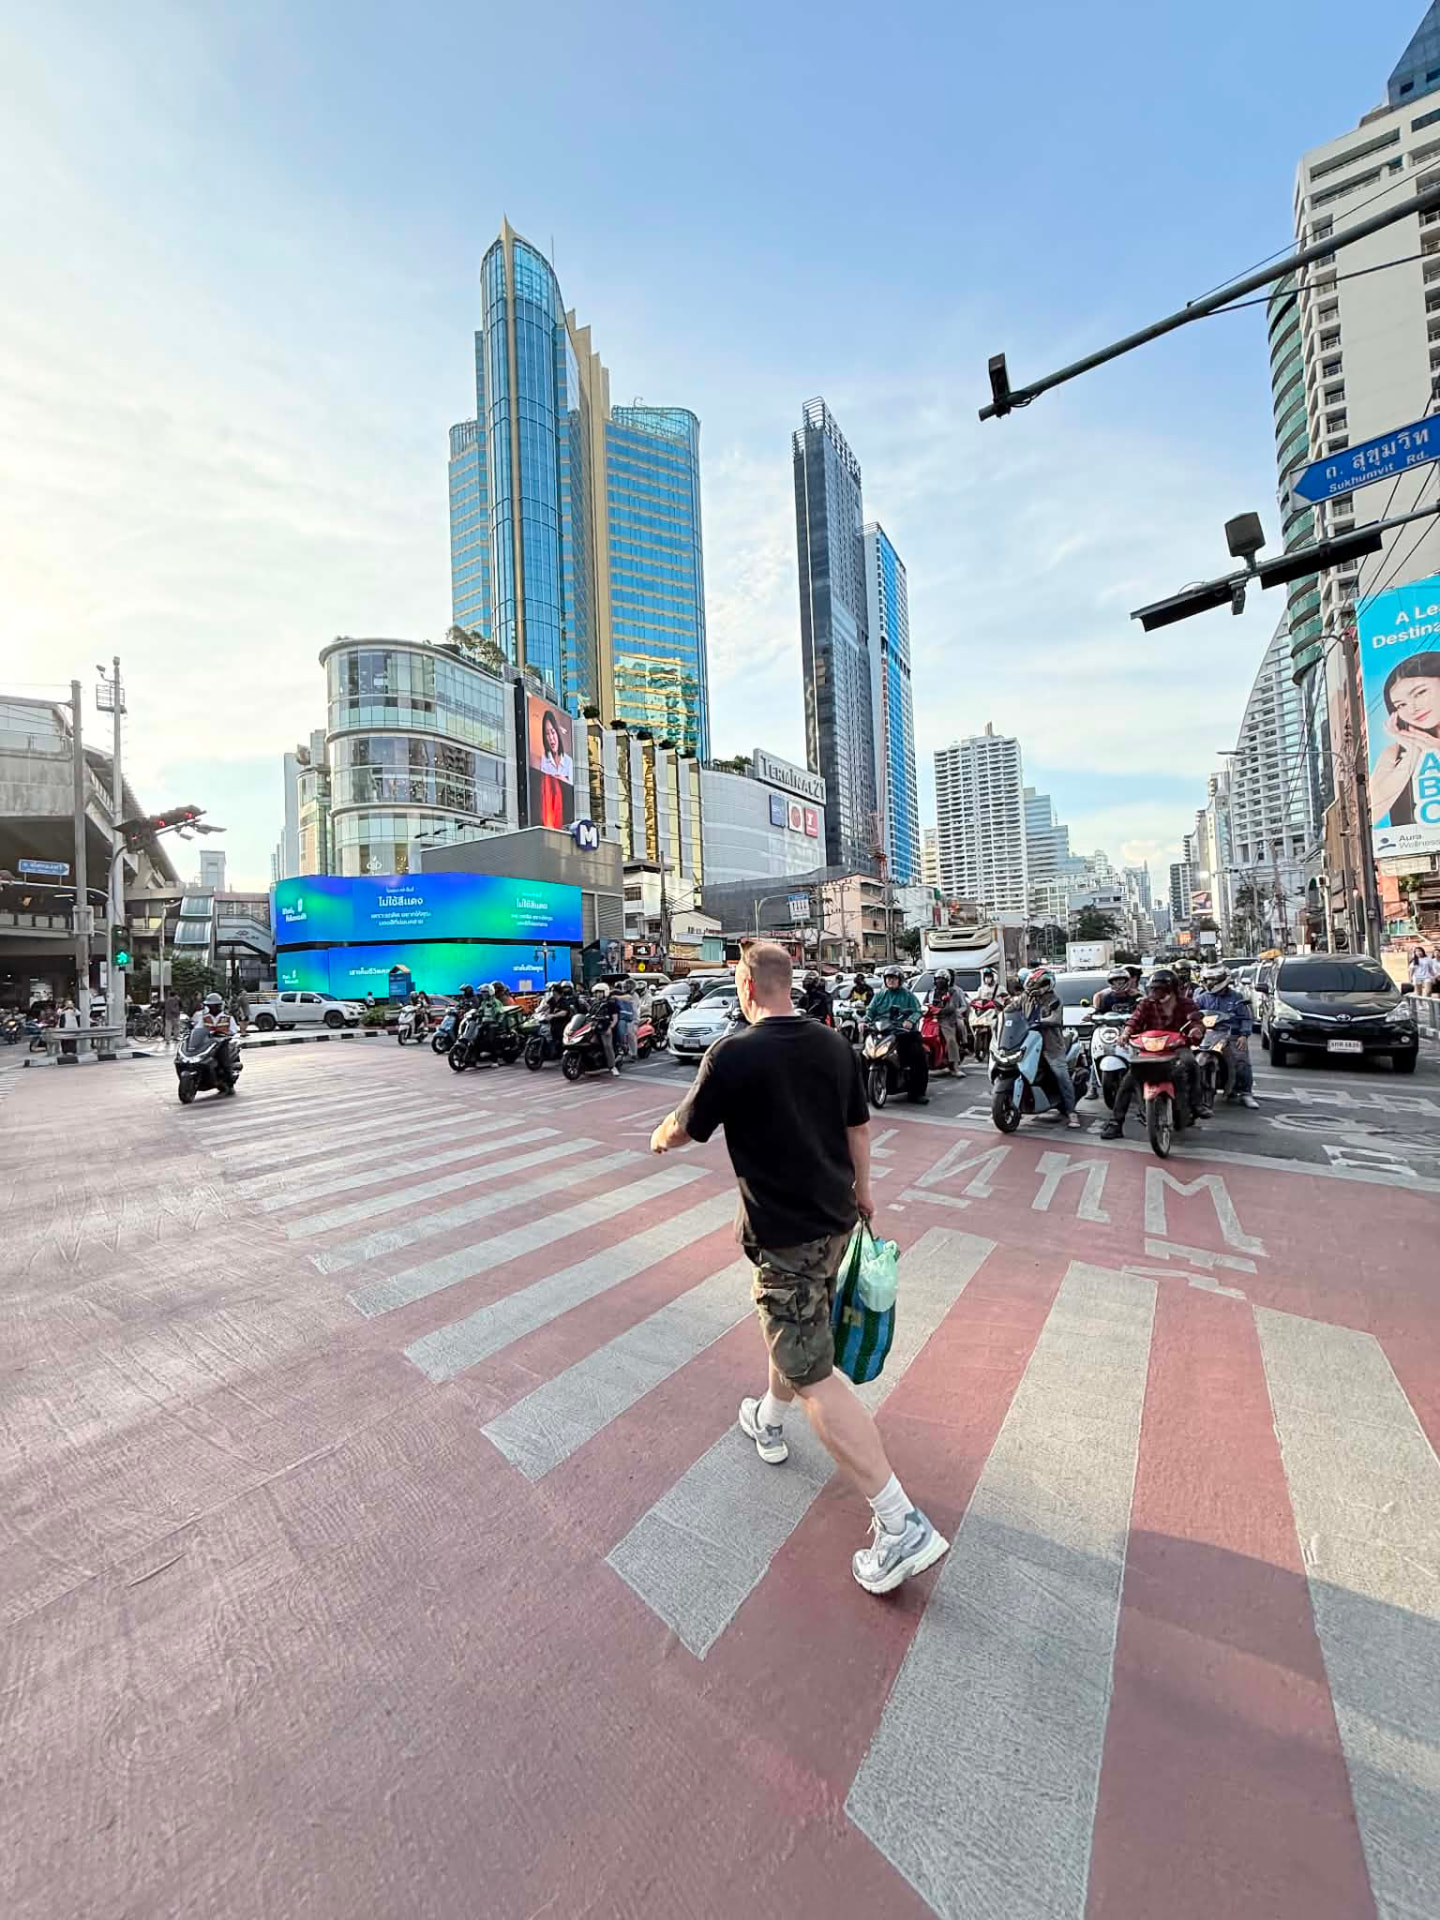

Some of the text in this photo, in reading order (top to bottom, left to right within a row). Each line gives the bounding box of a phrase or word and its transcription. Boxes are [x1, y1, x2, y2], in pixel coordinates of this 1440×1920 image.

[1352, 427, 1430, 471] สุขุมวิท
[1328, 450, 1430, 494] Sukhumvit Rd.
[1395, 603, 1440, 625] A Le
[579, 824, 598, 848] M
[1399, 834, 1422, 842] Aura
